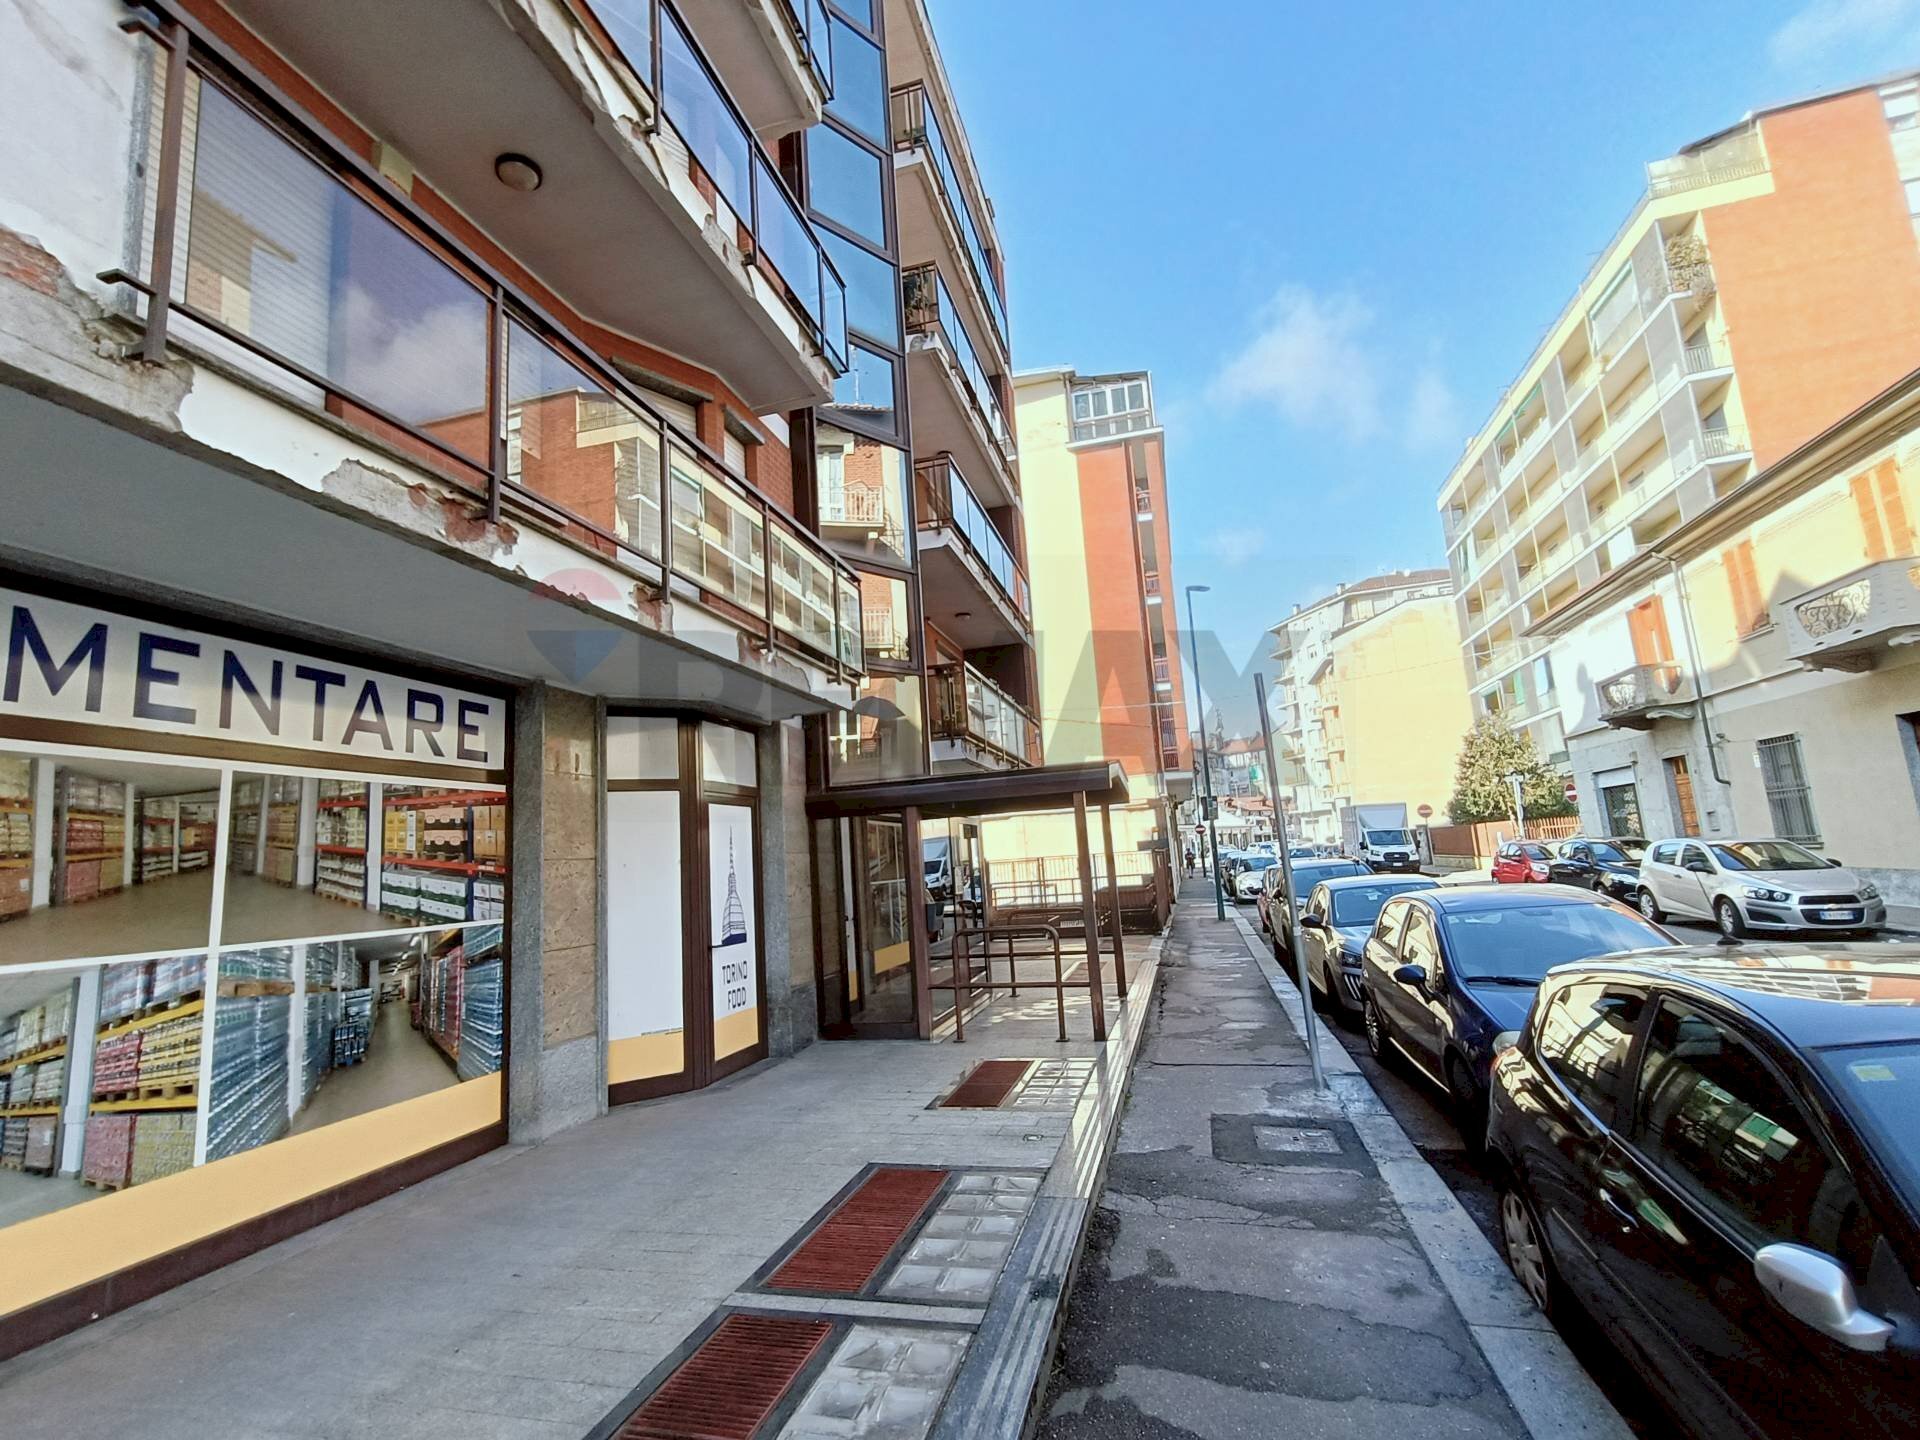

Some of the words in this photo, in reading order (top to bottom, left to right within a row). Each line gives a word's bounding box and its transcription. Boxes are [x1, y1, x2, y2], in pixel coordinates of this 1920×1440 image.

[3, 605, 490, 763] MENTARE
[721, 960, 748, 985] TORINO
[727, 986, 747, 1010] FOOD
